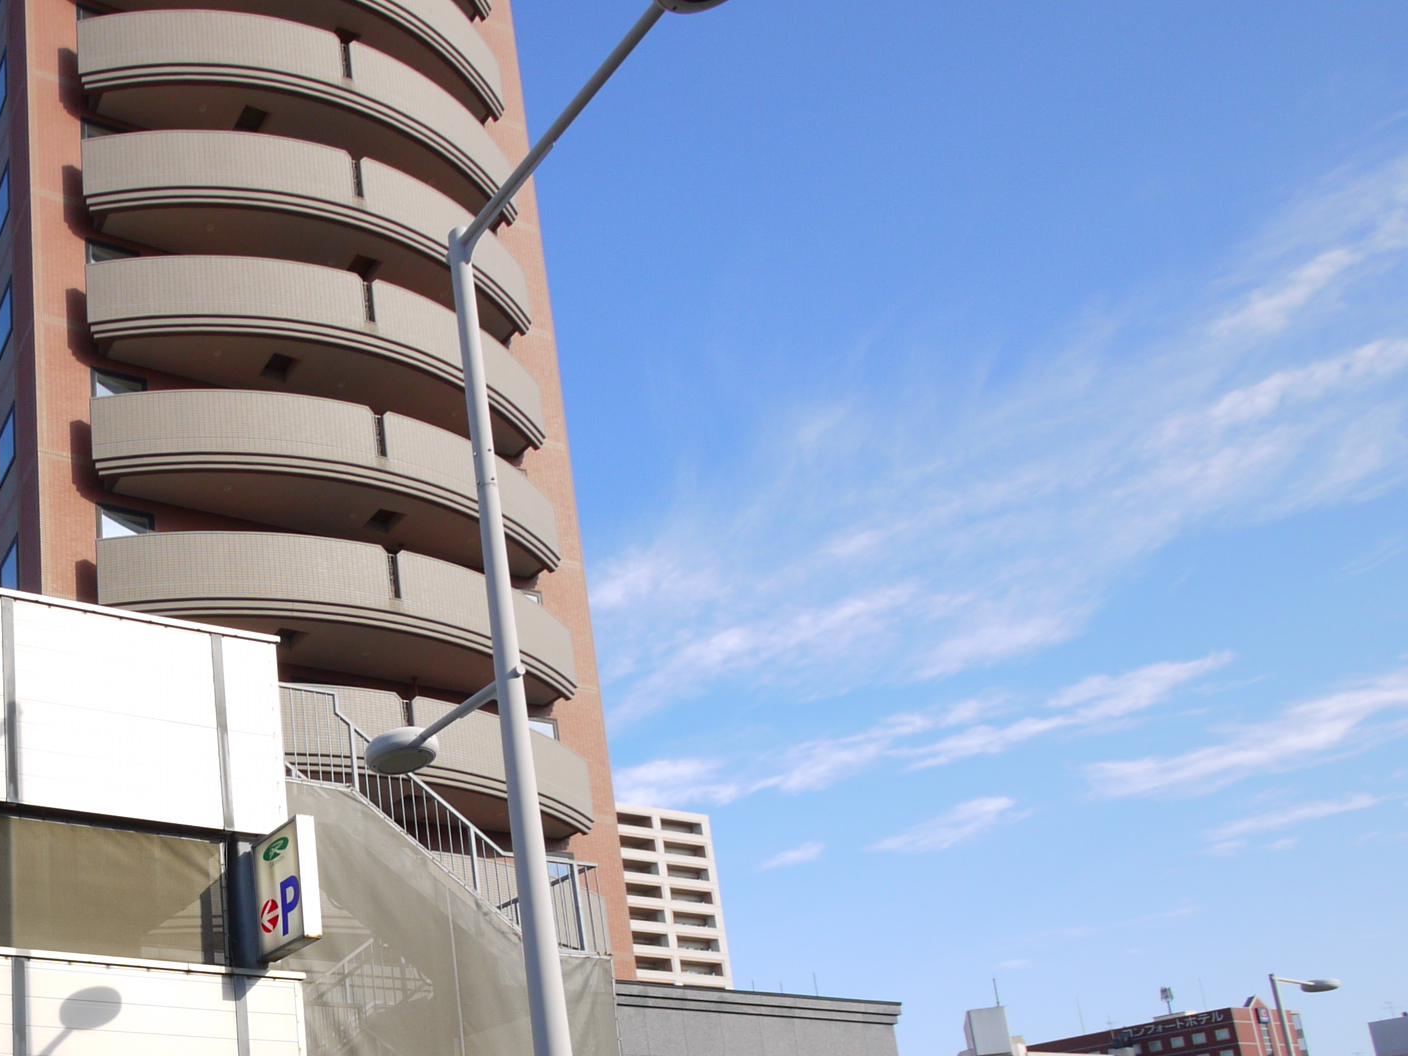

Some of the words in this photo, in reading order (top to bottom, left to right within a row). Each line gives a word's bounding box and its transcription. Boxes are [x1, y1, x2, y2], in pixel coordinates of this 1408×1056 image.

[280, 875, 300, 937] P
[1123, 1011, 1224, 1037] コンフォートホテル
